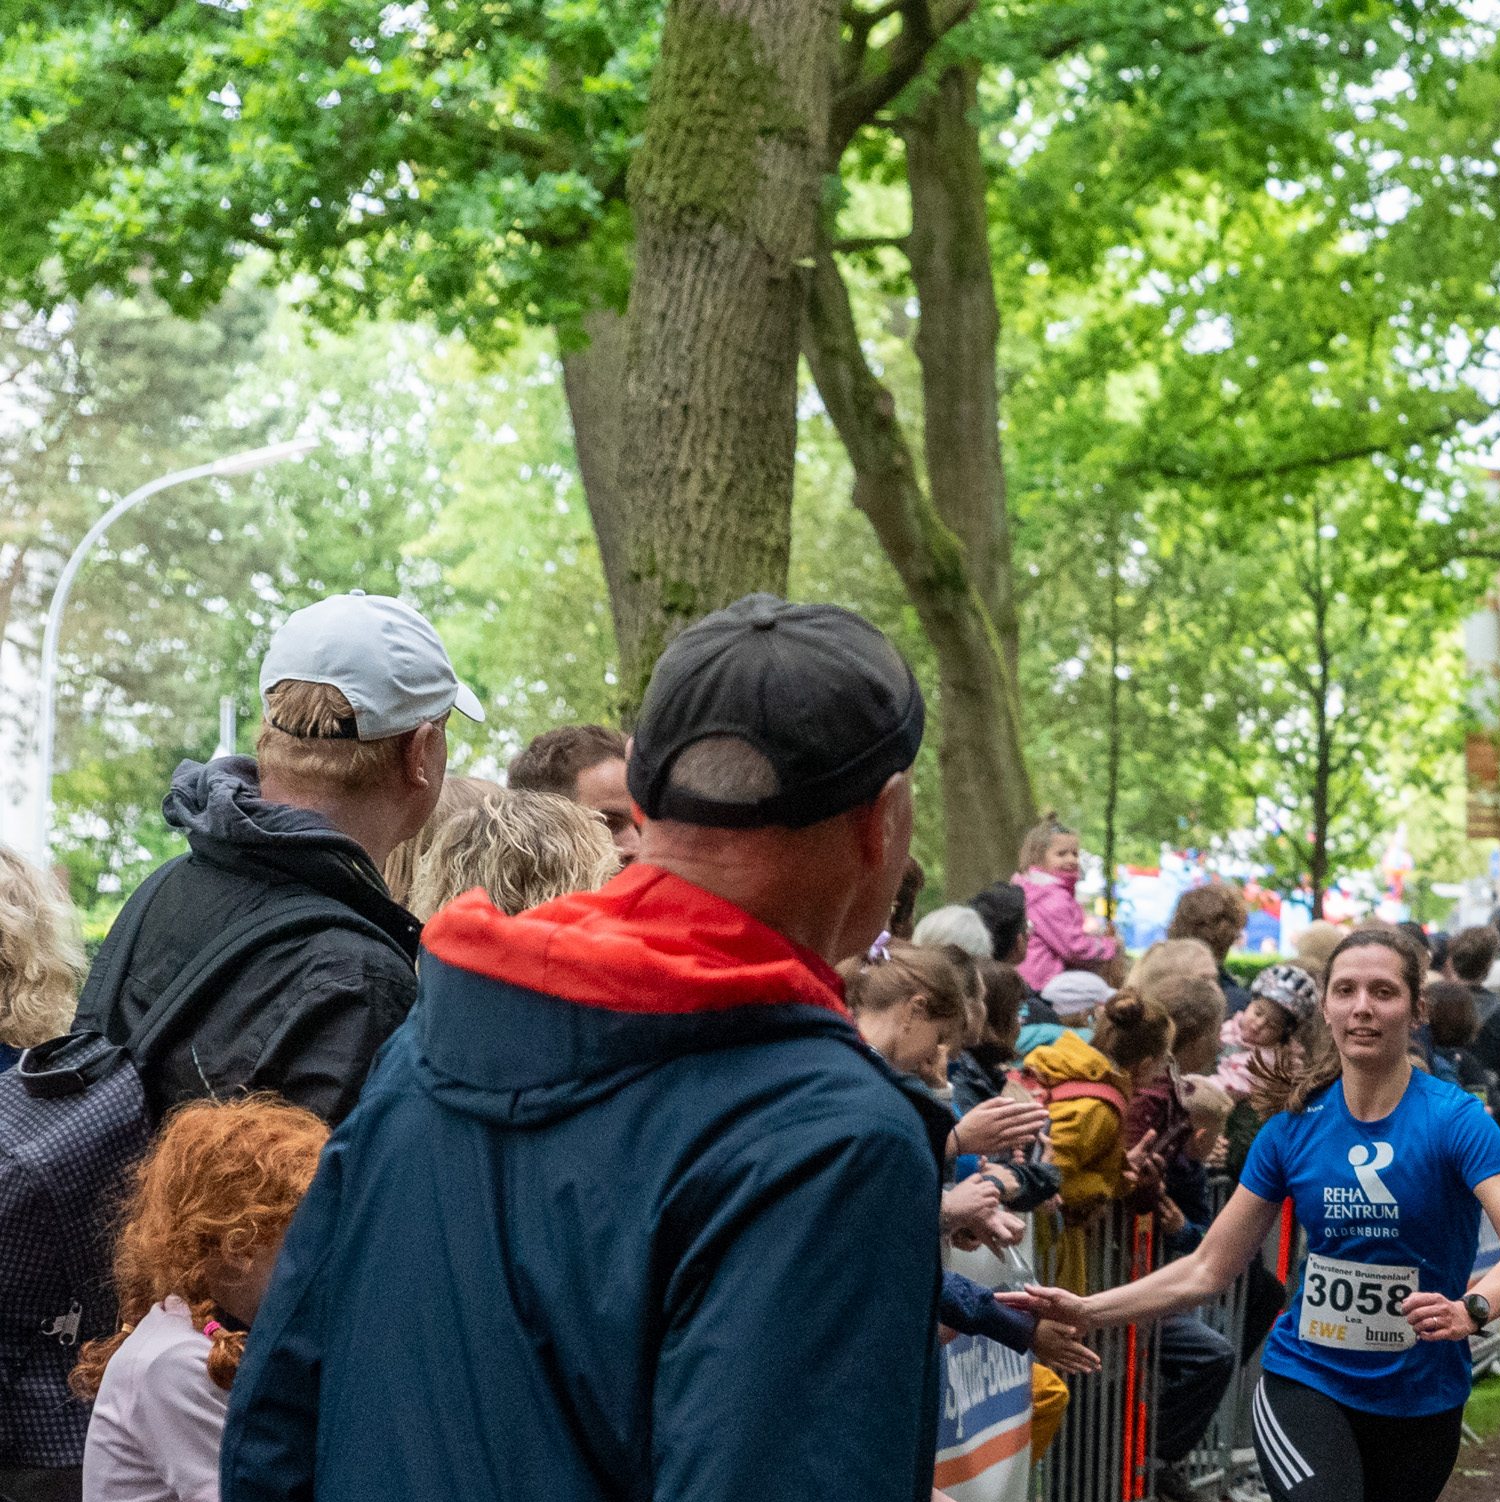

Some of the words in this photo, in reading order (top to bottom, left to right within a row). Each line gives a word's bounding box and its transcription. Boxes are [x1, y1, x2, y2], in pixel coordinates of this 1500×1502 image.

[1323, 1187, 1365, 1203] REHA
[1323, 1204, 1399, 1219] ZENTRUM
[1324, 1226, 1400, 1238] OLDENBURG
[1312, 1261, 1353, 1276] Everstener
[1354, 1269, 1411, 1281] Brunnenlauf
[1305, 1273, 1413, 1317] 3058
[1345, 1315, 1363, 1324] Lea
[1308, 1319, 1349, 1341] EWE
[1365, 1325, 1405, 1342] bruns
